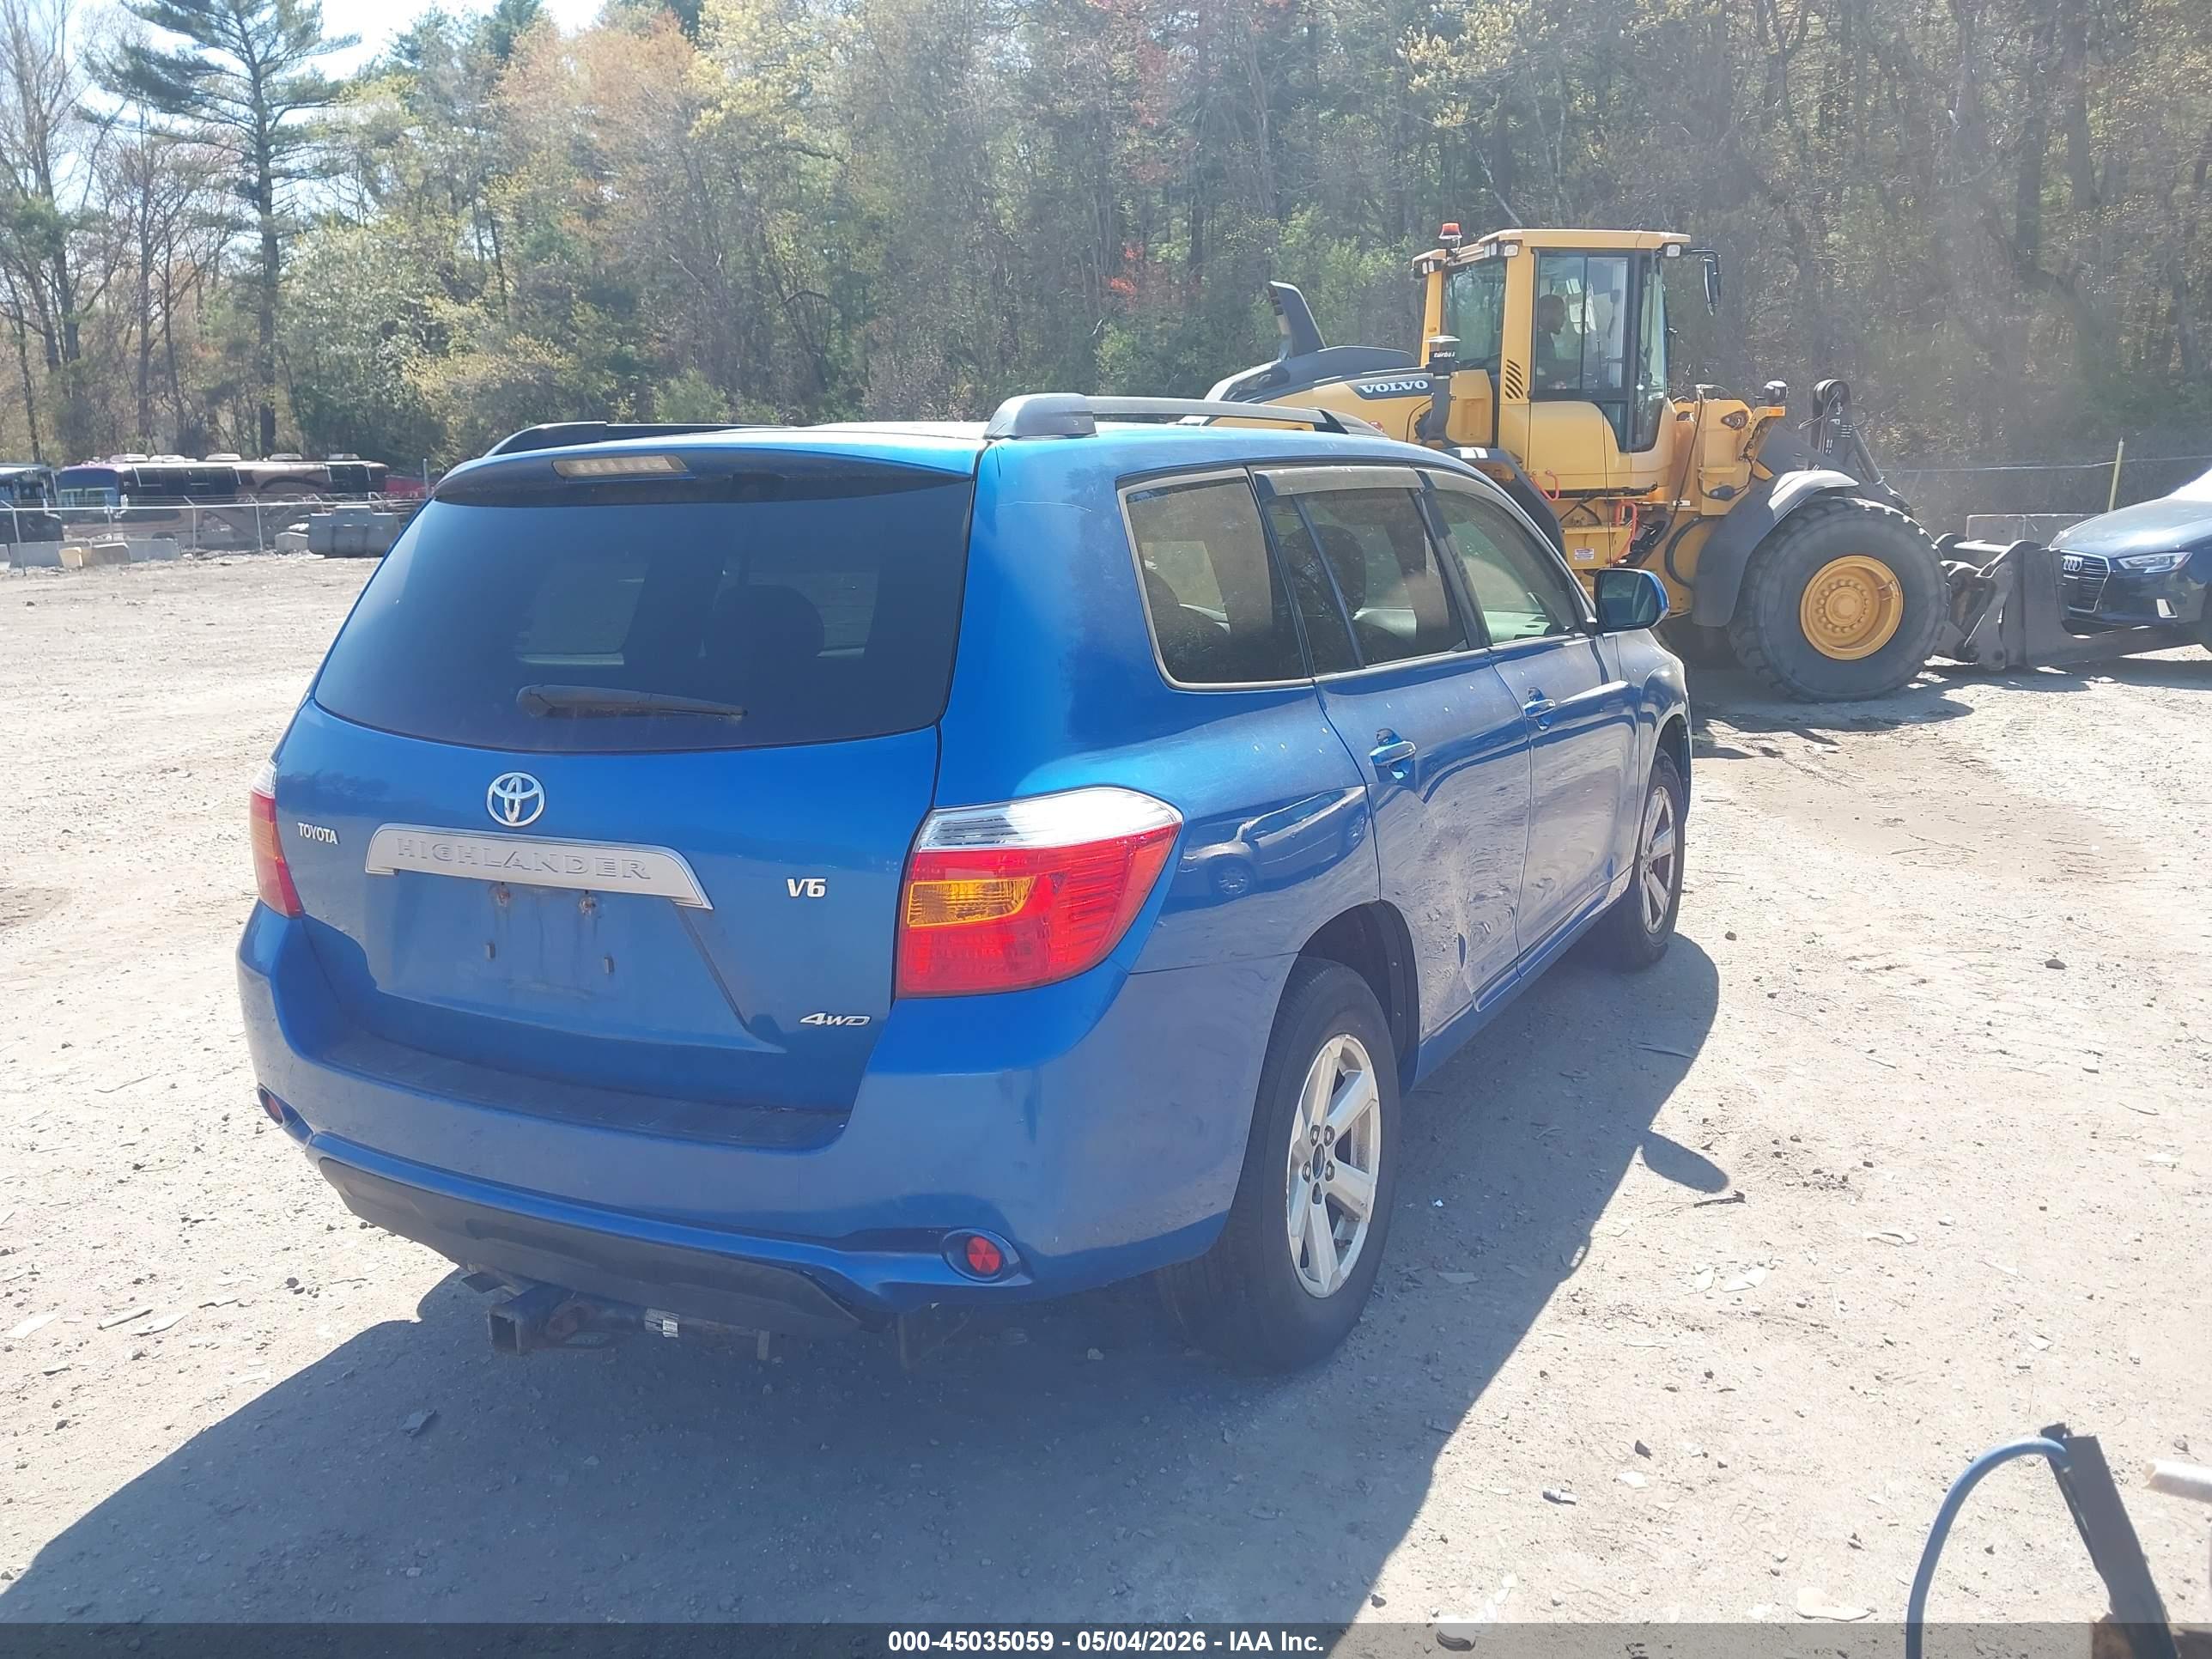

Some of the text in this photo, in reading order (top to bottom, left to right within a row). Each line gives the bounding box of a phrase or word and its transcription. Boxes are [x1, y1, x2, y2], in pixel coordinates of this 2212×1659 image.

[1358, 380, 1429, 393] VOLVO
[297, 822, 338, 845] TOYOTA
[396, 837, 652, 880] HIGHLANDER
[787, 878, 826, 897] V6
[799, 1012, 871, 1026] 4WD
